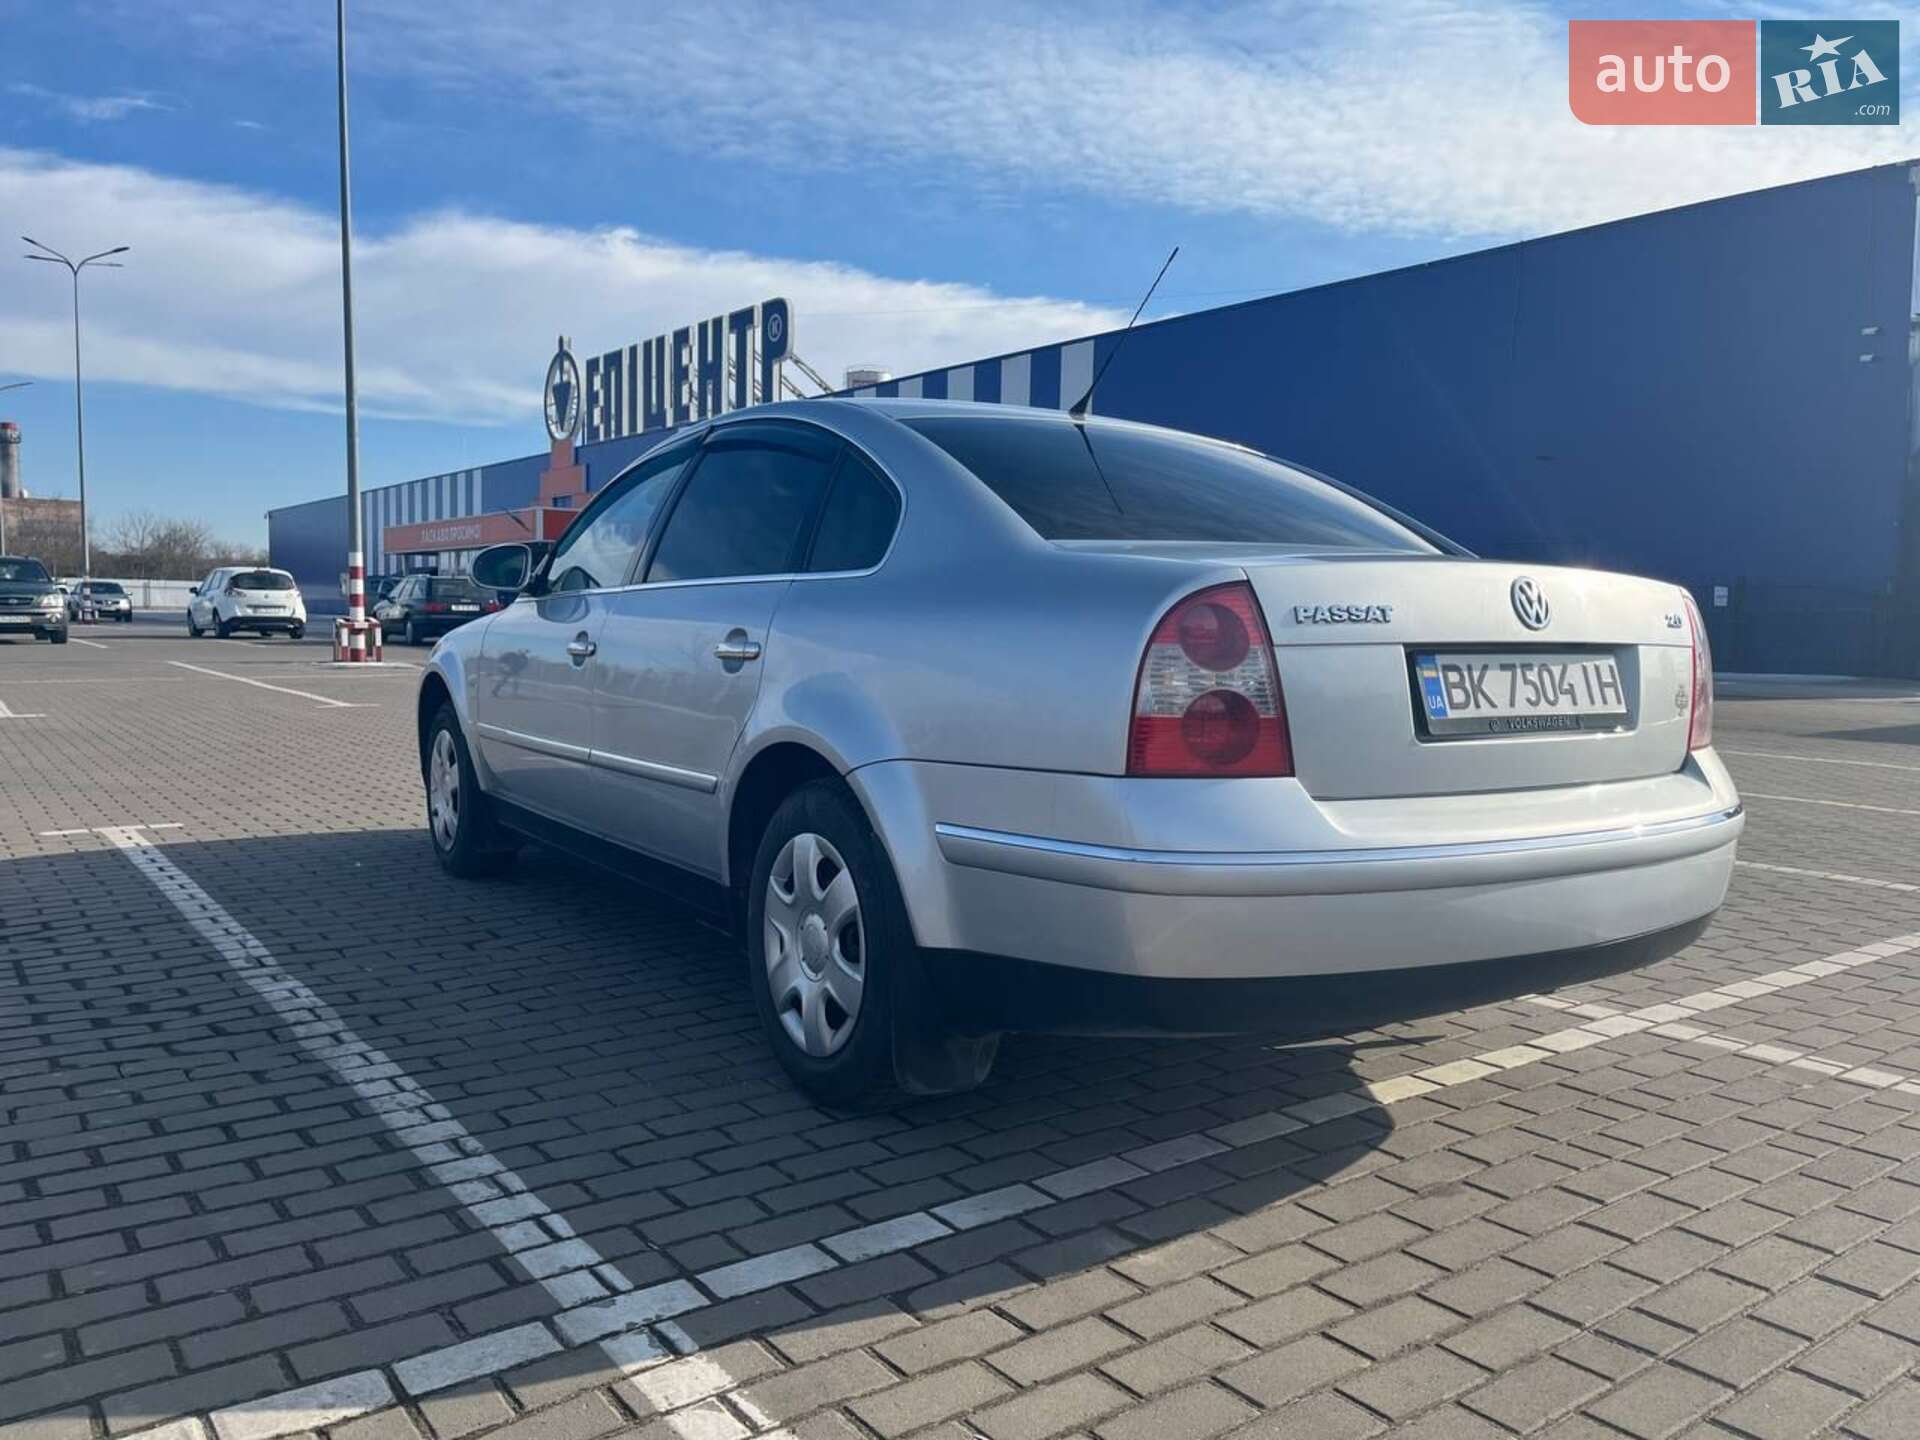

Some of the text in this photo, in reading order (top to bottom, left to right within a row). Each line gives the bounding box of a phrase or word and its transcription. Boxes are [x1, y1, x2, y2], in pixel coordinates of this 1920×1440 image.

[585, 296, 794, 444] ЕПІЦЕНТР
[1293, 605, 1393, 624] PASSAT
[1440, 663, 1622, 710] BK 7504 IH
[1427, 695, 1445, 709] UA
[1508, 716, 1571, 728] VOLKSWAGEN
